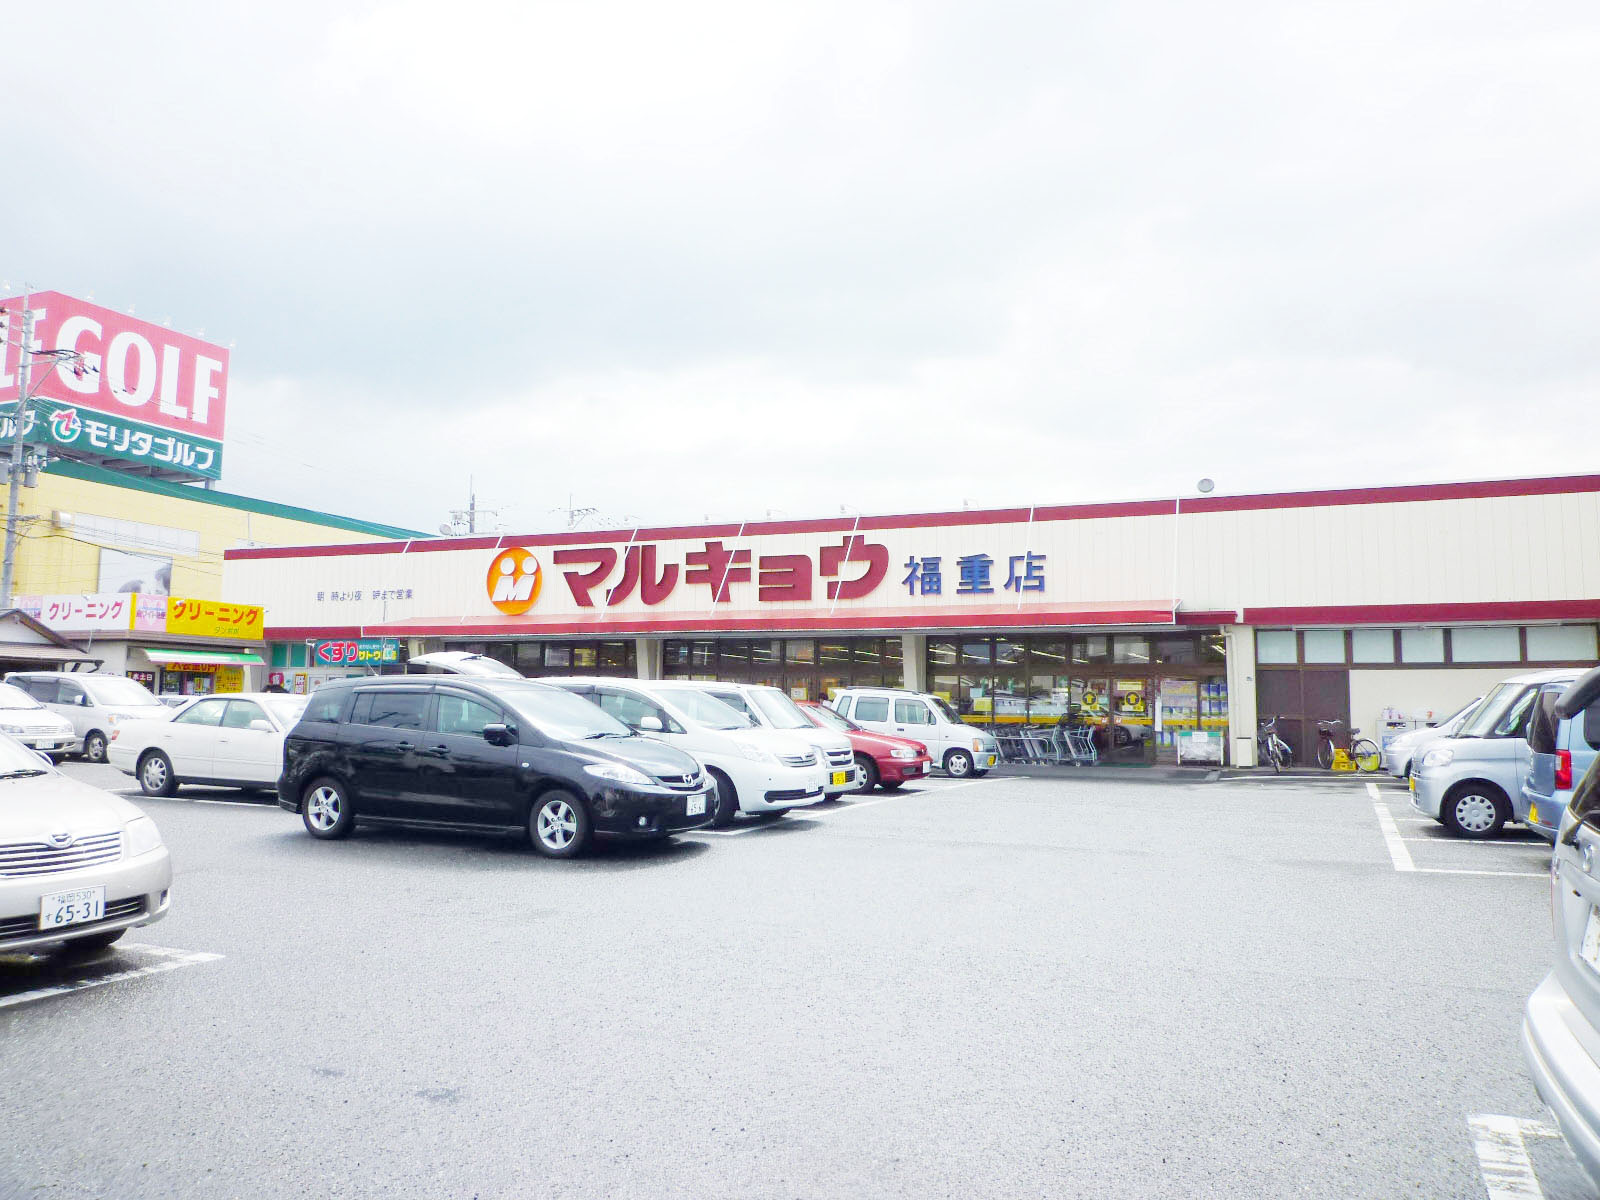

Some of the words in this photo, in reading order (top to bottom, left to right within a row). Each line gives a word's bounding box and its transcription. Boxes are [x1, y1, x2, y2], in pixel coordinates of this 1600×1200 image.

[55, 315, 222, 424] GOLF
[85, 419, 214, 469] モリタゴルフ
[553, 535, 889, 606] マルキョウ
[902, 551, 1047, 595] 福重店
[49, 601, 123, 620] クリーニング
[173, 602, 259, 625] クリーニング
[318, 641, 359, 662] くすり
[55, 900, 99, 923] 65-31
